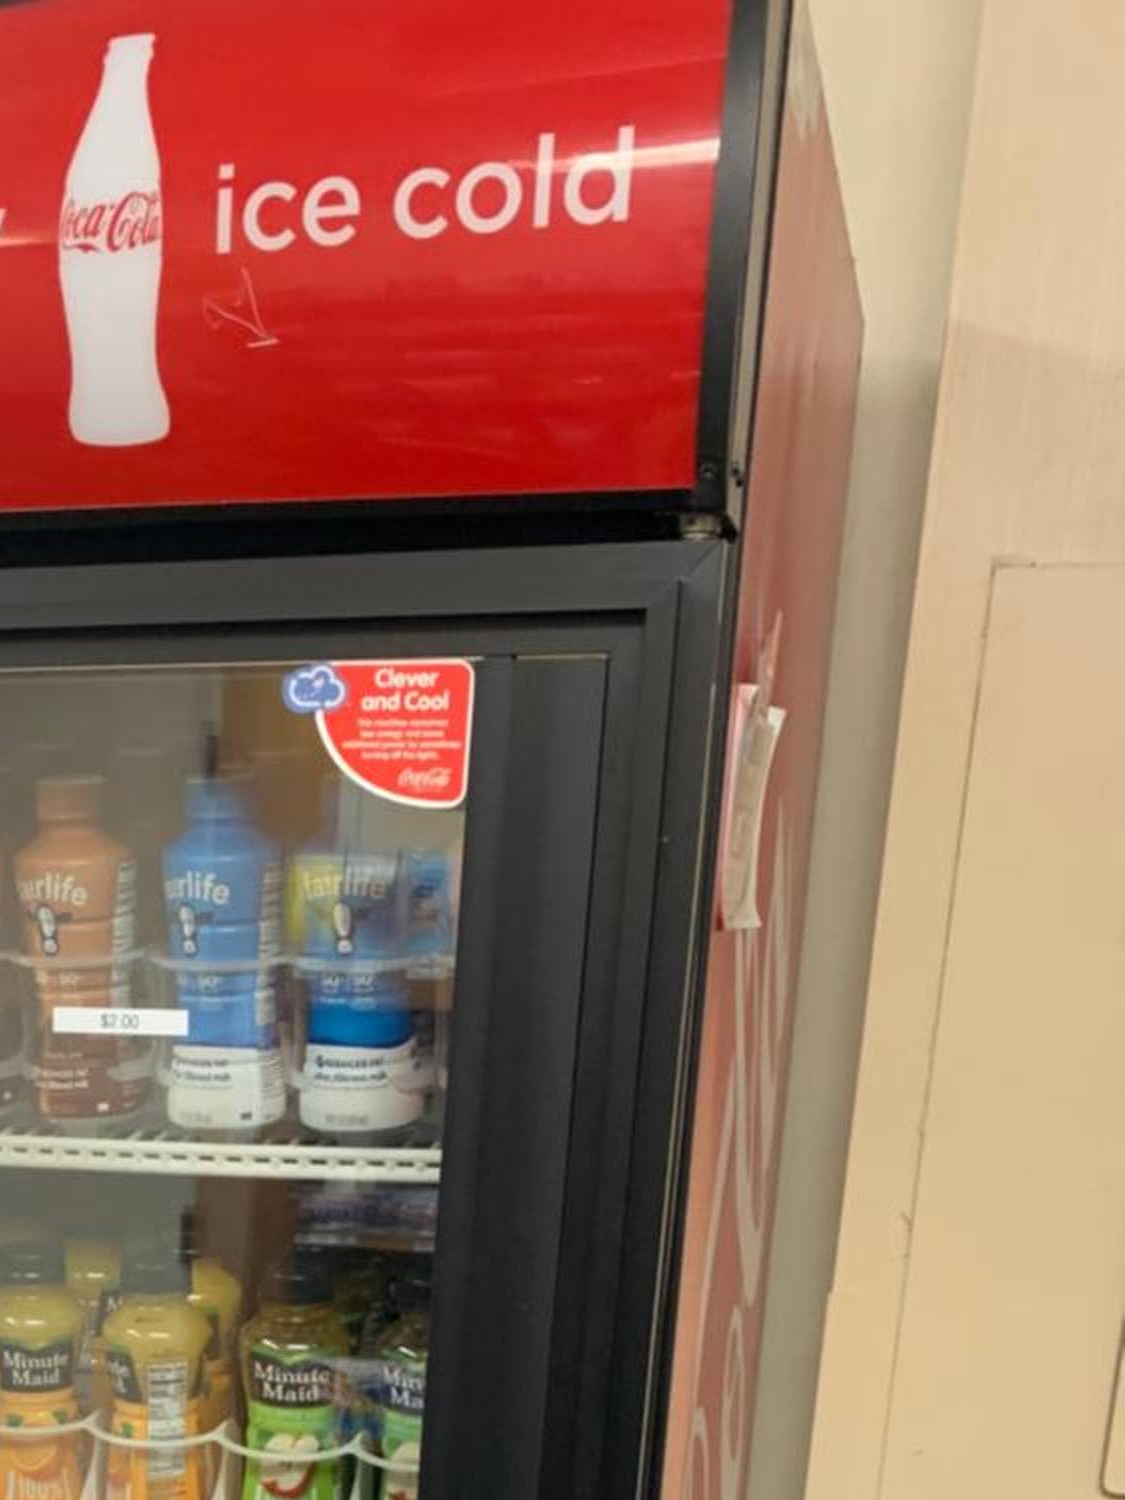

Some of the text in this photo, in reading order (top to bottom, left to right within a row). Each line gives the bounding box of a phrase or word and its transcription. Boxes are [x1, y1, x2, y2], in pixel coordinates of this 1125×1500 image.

[213, 125, 636, 255] ice cold
[375, 667, 440, 689] Clever
[361, 689, 451, 712] and Cool
[164, 870, 231, 906] airlife
[2, 1349, 69, 1371] Minute
[12, 1368, 60, 1387] Maid
[254, 1360, 330, 1384] Minute
[262, 1382, 320, 1403] Maid
